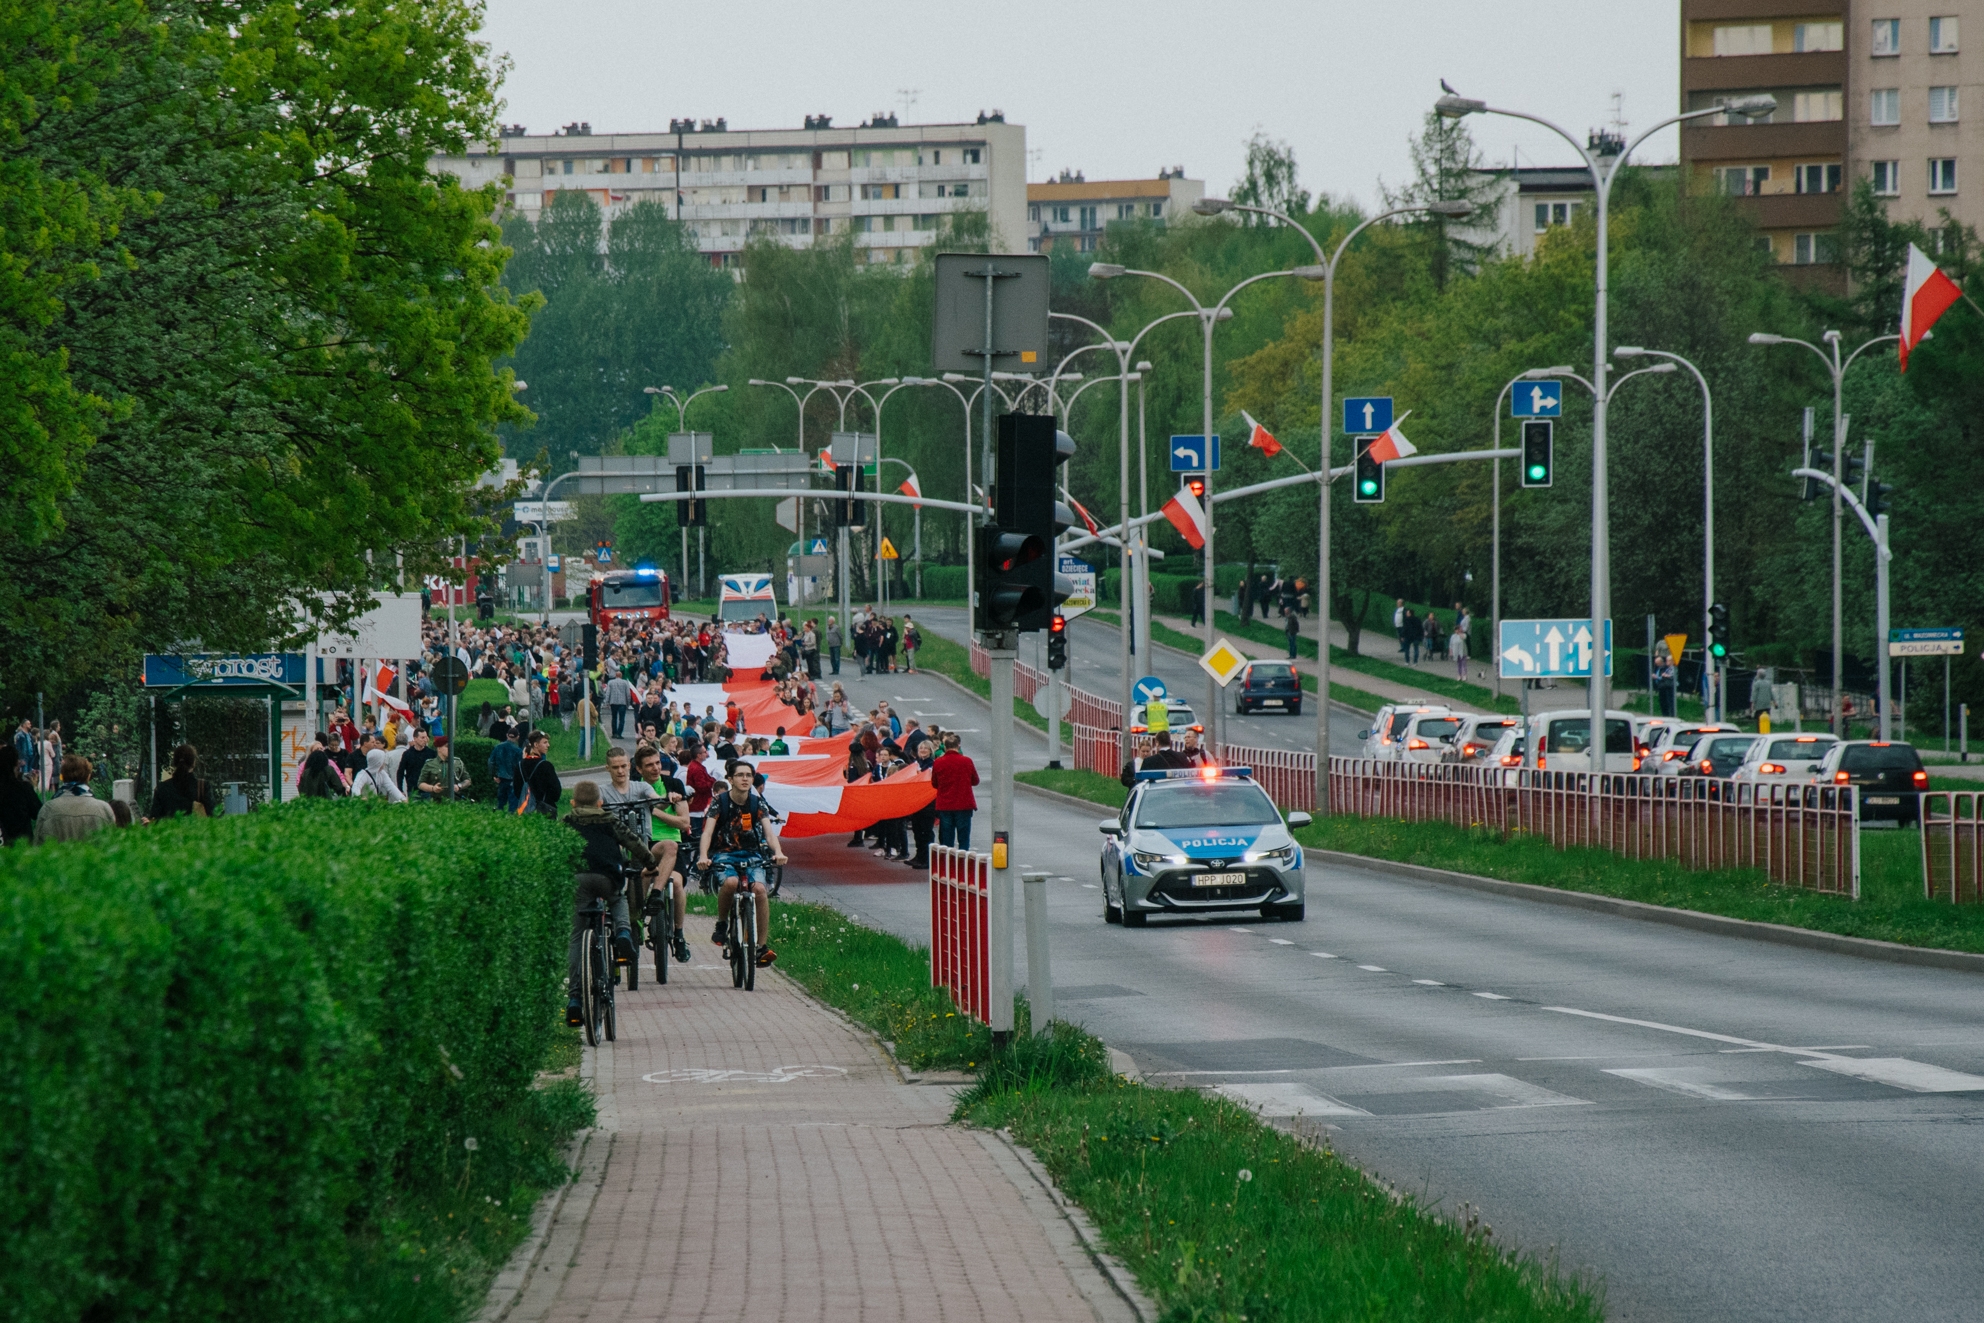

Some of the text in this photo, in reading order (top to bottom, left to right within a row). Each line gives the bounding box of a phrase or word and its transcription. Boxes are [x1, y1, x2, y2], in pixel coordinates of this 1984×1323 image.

[1901, 644, 1943, 653] POLICJA
[1173, 770, 1202, 778] POLICJ
[1182, 838, 1248, 849] POLICJA
[1197, 874, 1243, 886] HPP J020
